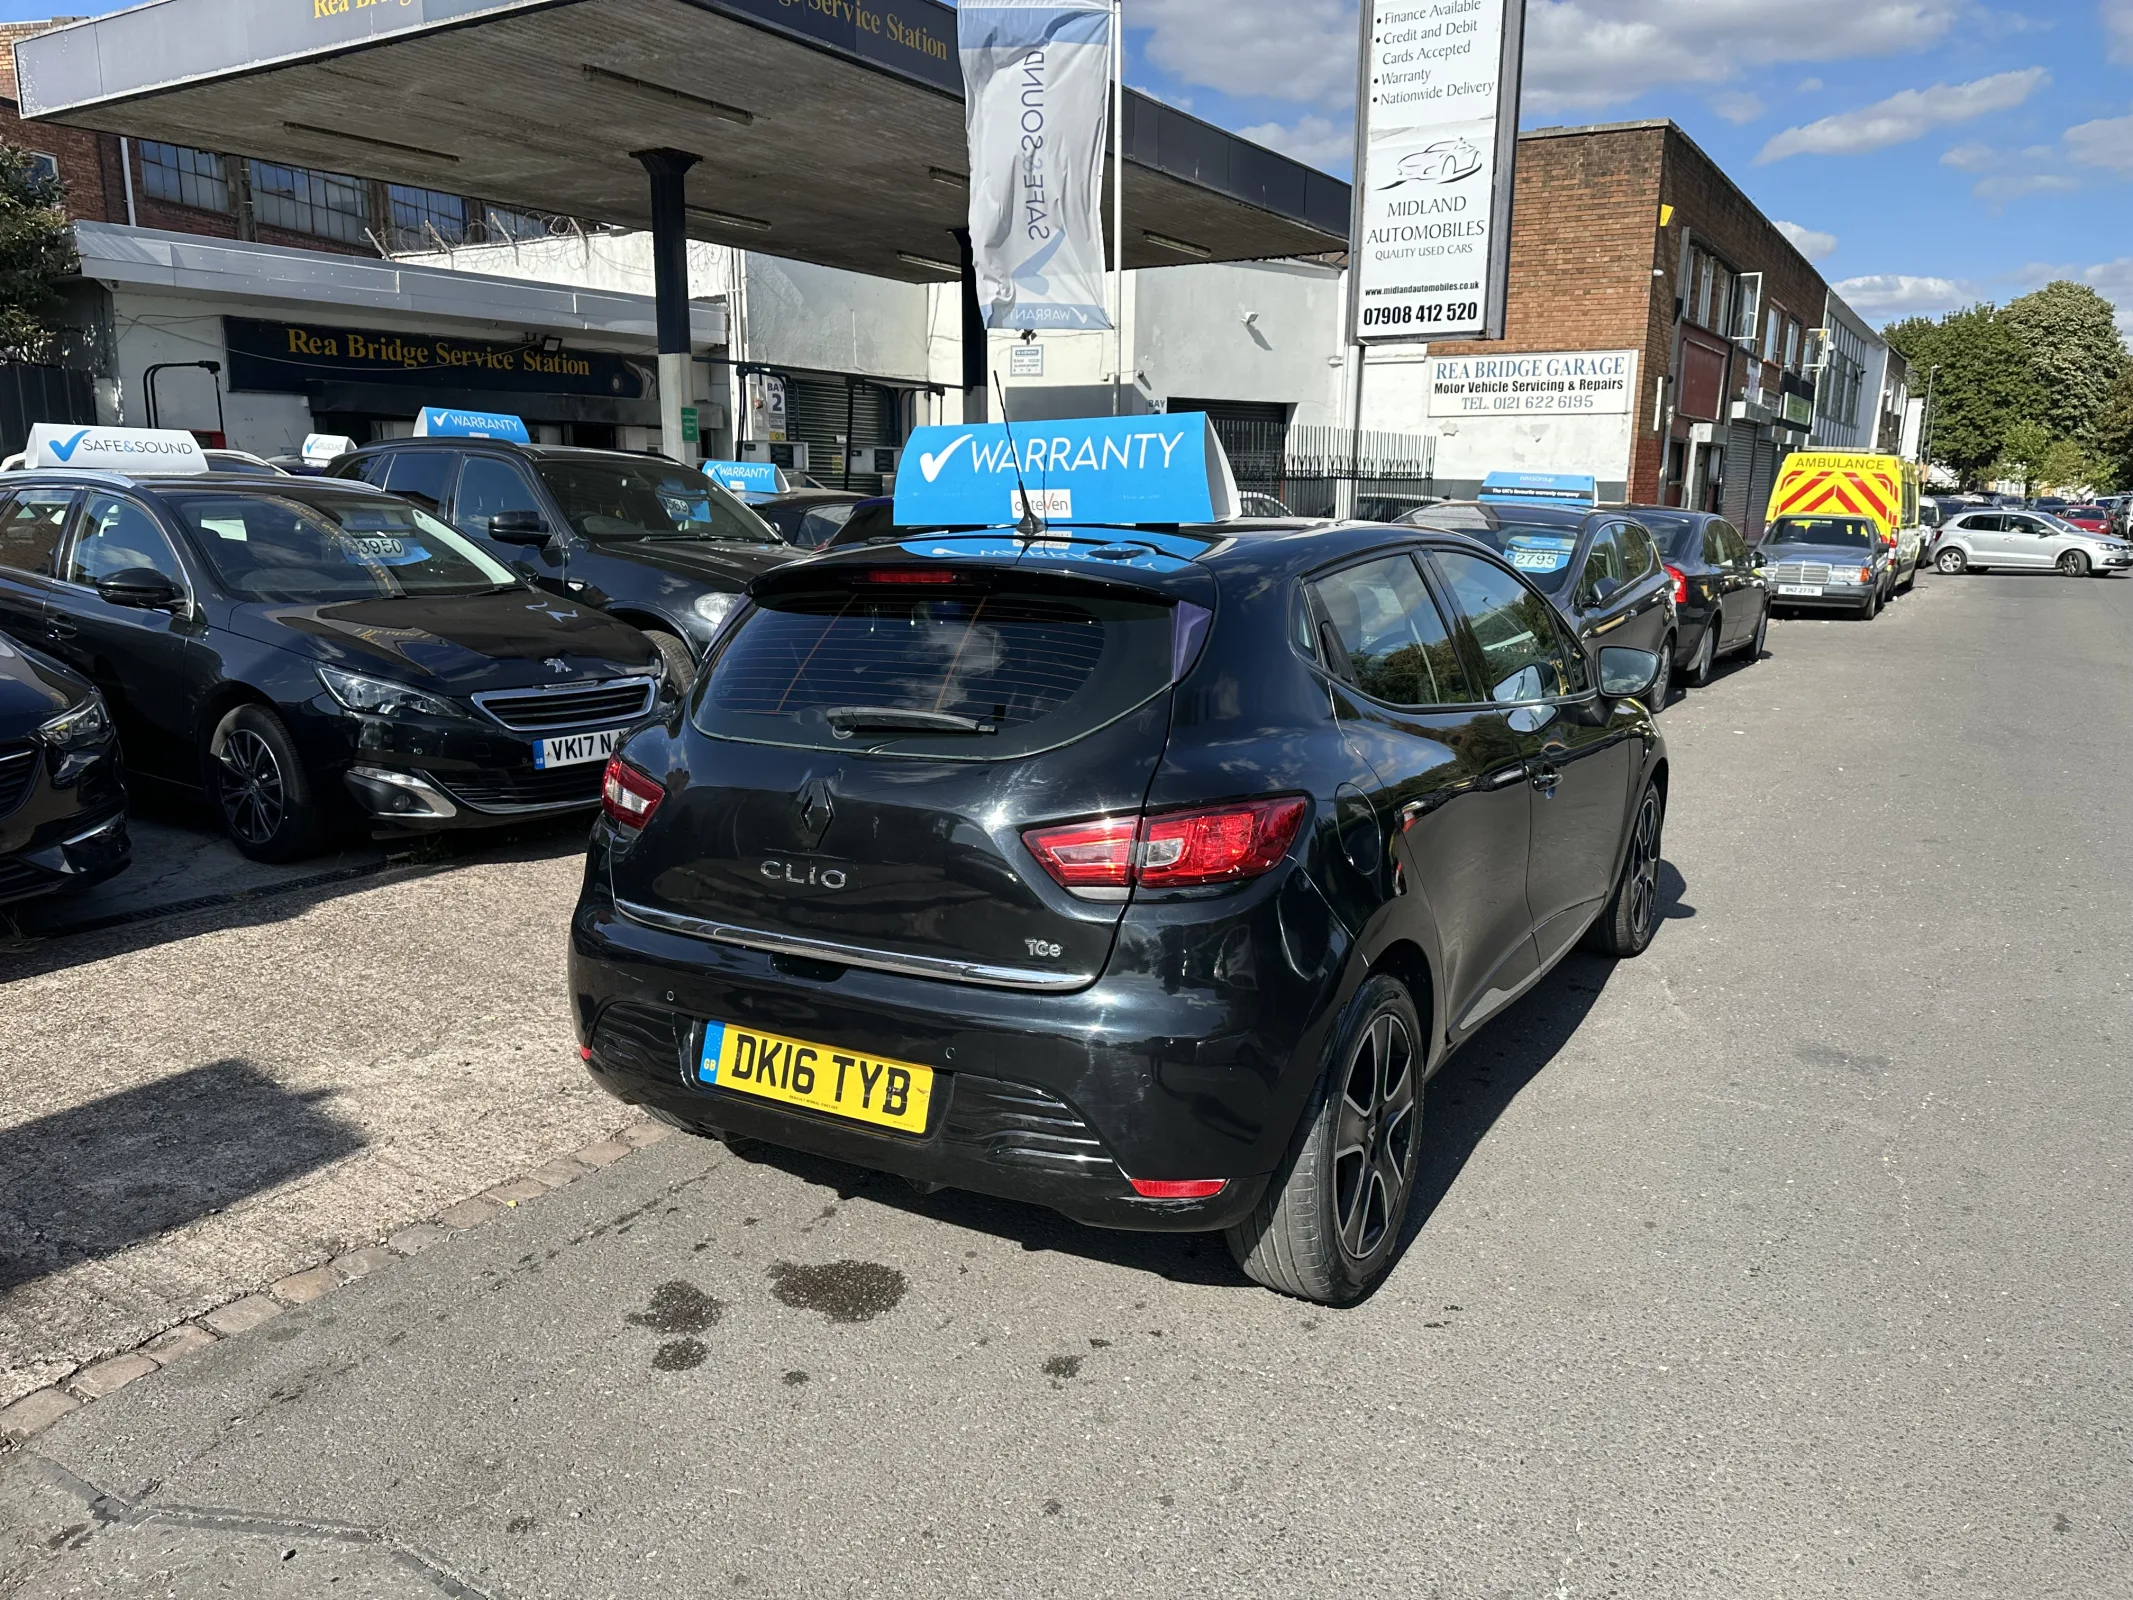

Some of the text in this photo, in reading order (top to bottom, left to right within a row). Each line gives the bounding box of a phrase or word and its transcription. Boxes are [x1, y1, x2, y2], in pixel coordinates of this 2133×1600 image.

[1384, 0, 1481, 25] Finance Available
[886, 13, 947, 60] Station
[1383, 19, 1478, 45] Credit and Debit
[1382, 40, 1471, 65] Cards Accepted
[1381, 69, 1432, 86] Warranty
[1380, 80, 1495, 105] Nationwide Delivery
[1387, 195, 1467, 218] MIDLAND
[1366, 219, 1485, 245] AUTOMOBILES
[1375, 243, 1473, 261] QUALITY USED CARS
[1365, 281, 1480, 296] www.midlandautomobiles.co.uk
[1363, 301, 1478, 326] 07908 412 520
[286, 328, 590, 376] Rea Bridge Service Station
[1436, 356, 1625, 380] REA BRIDGE GARAGE
[1434, 377, 1624, 394] Motor Vehicle Servicing & Repairs
[772, 393, 782, 411] 2
[1148, 399, 1165, 408] BAY
[1461, 394, 1594, 410] TEL. 0121 622 6195
[449, 413, 519, 432] WARRANTY
[82, 438, 193, 455] SAFE&SOUND
[971, 431, 1185, 474] WARRANTY
[720, 466, 770, 478] WARRANTY
[1795, 457, 1885, 471] AMBULANCE
[551, 735, 595, 762] VK17
[760, 860, 847, 889] CLIO
[1024, 938, 1062, 958] TCe
[703, 1058, 716, 1072] GB
[731, 1033, 911, 1117] DK16 TYB
